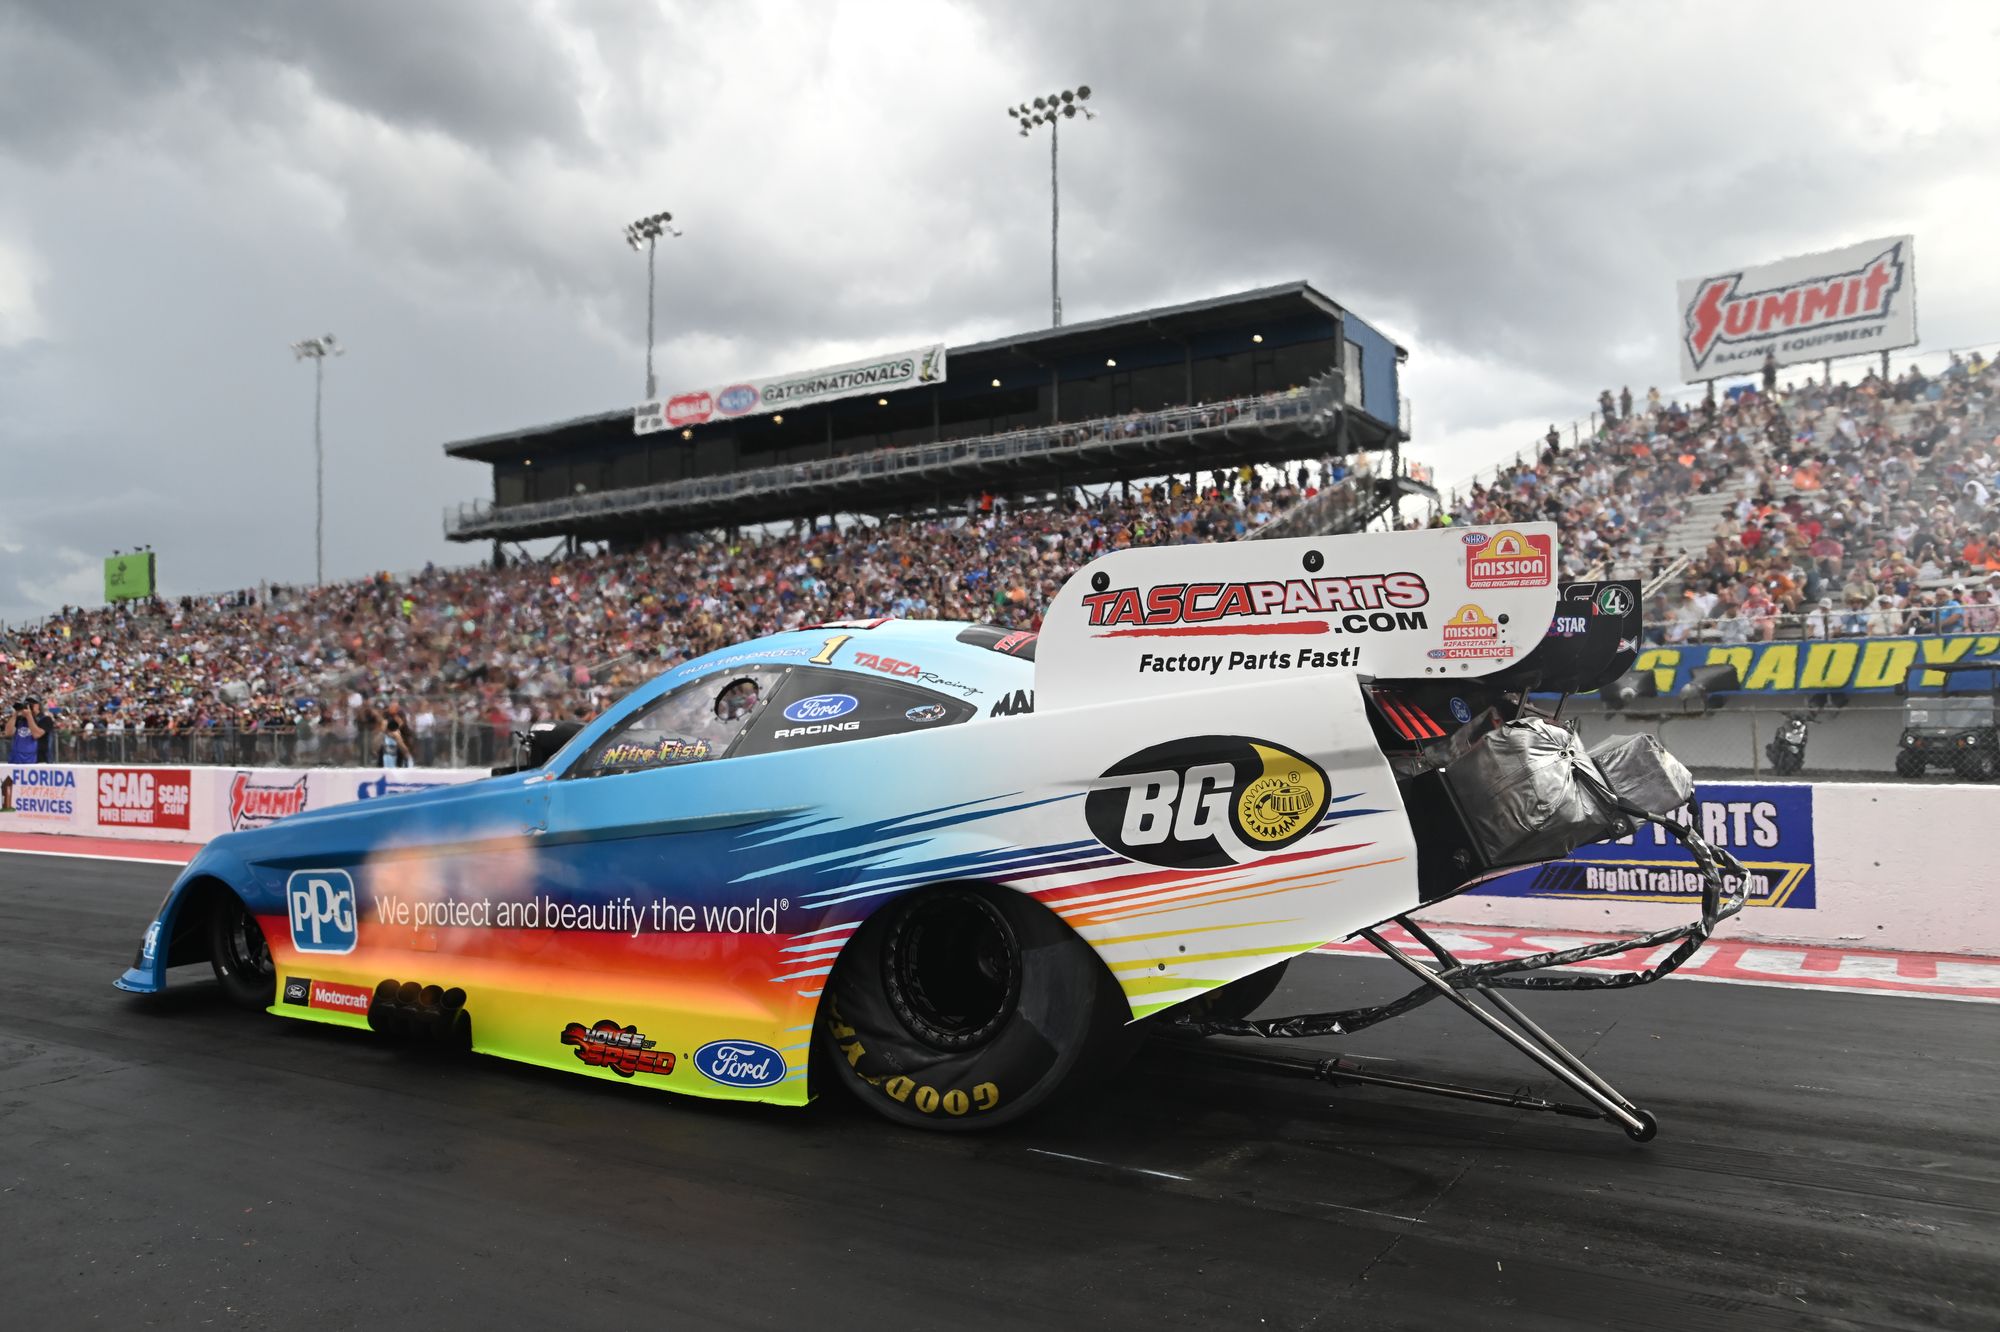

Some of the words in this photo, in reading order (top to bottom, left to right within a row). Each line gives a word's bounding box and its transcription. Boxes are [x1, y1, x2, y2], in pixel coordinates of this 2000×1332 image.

[1714, 343, 1777, 364] RACING
[1782, 325, 1885, 352] EQUIPMENT
[763, 361, 912, 401] GATORNATIONALS
[1465, 533, 1487, 545] NHRA
[1474, 559, 1543, 577] MISSION
[1491, 580, 1520, 588] RACING
[1519, 578, 1548, 586] SERIES
[1334, 611, 1428, 634] .COM
[1445, 626, 1496, 638] MISSION
[1556, 617, 1586, 633] STAR
[808, 634, 855, 666] 1
[1443, 639, 1498, 648] #2FAST2TASTY
[1448, 648, 1511, 658] CHALLENGE
[678, 655, 744, 677] AUSTIN
[744, 647, 811, 660] PROCK
[1139, 653, 1224, 676] Factory
[1228, 650, 1292, 671] Parts
[1296, 646, 1361, 669] Fast!
[853, 651, 921, 679] TASCA
[915, 671, 984, 697] Racing
[774, 721, 861, 739] RACING
[601, 743, 656, 766] Nitro
[658, 739, 711, 762] Fish
[13, 769, 76, 788] FLORIDA
[20, 786, 68, 799] PORTABLE
[99, 772, 155, 808] SCAG
[158, 784, 189, 805] SCAG
[16, 798, 73, 815] SERVICES
[99, 807, 120, 823] POWER
[161, 802, 185, 816] .COM
[1094, 762, 1237, 849] BG
[291, 878, 354, 944] PPG
[374, 895, 410, 926] We
[413, 896, 492, 932] protect
[496, 895, 540, 928] and
[545, 895, 646, 938] beautify
[651, 896, 696, 932] the
[315, 987, 368, 1009] Motorcraft
[583, 1028, 645, 1050] HOUSE
[642, 1040, 657, 1050] OF
[585, 1044, 677, 1076] SPEED
